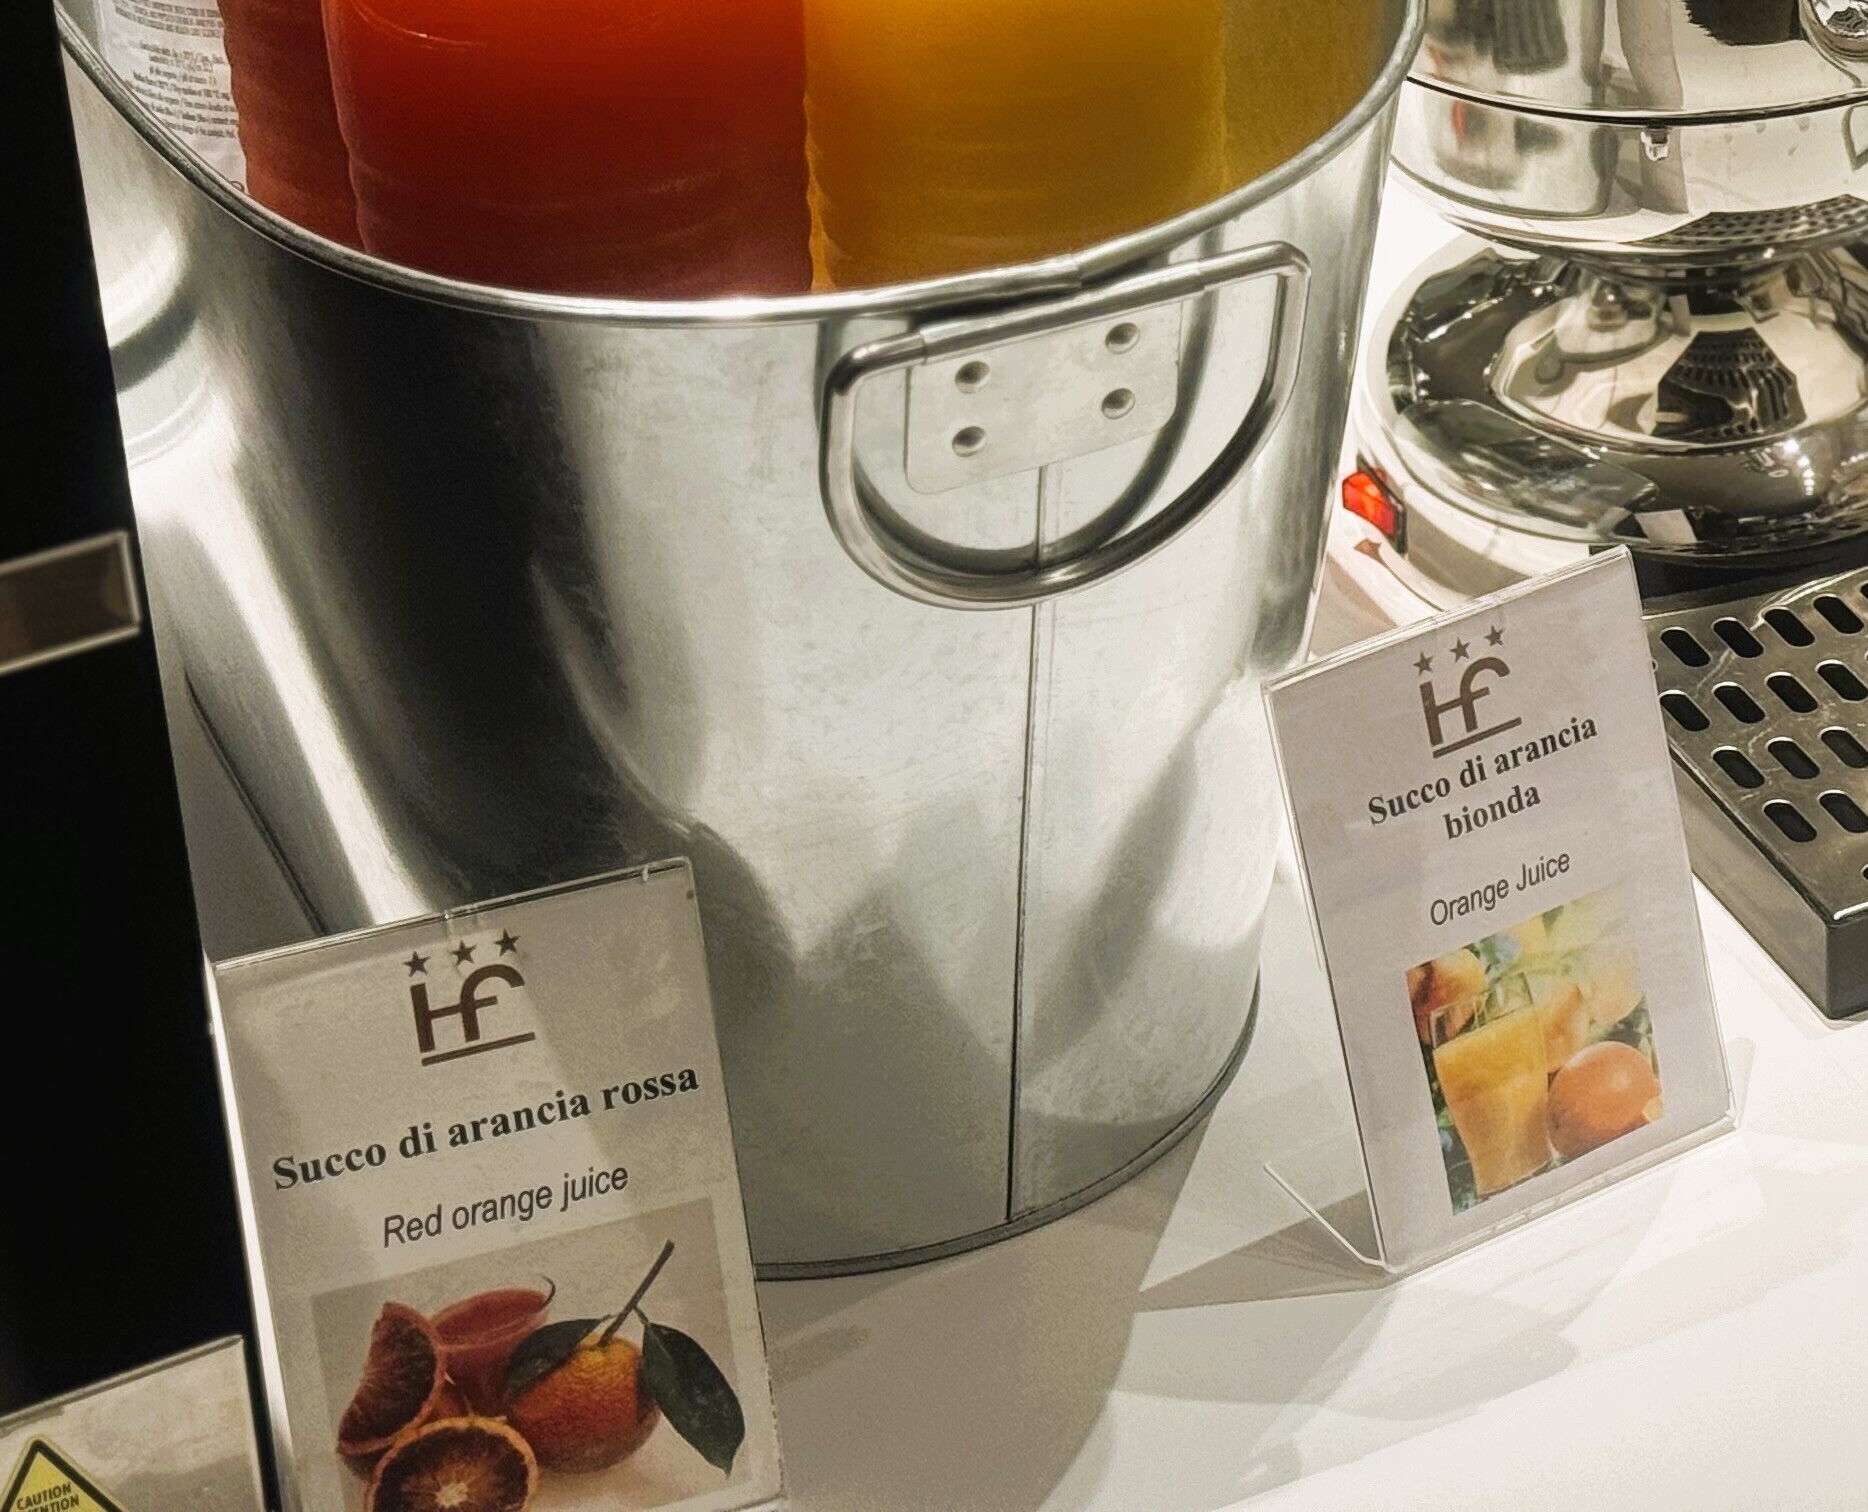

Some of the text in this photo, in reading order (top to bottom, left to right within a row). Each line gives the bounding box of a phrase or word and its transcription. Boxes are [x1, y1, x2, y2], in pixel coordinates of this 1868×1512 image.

[1368, 716, 1599, 826] Succo di arancia
[1443, 782, 1541, 839] bionda
[1430, 852, 1571, 926] Orange Juice
[273, 1068, 700, 1190] Succo di arancia rossa
[383, 1164, 628, 1248] Red orange juice
[16, 1481, 71, 1510] CAUTION
